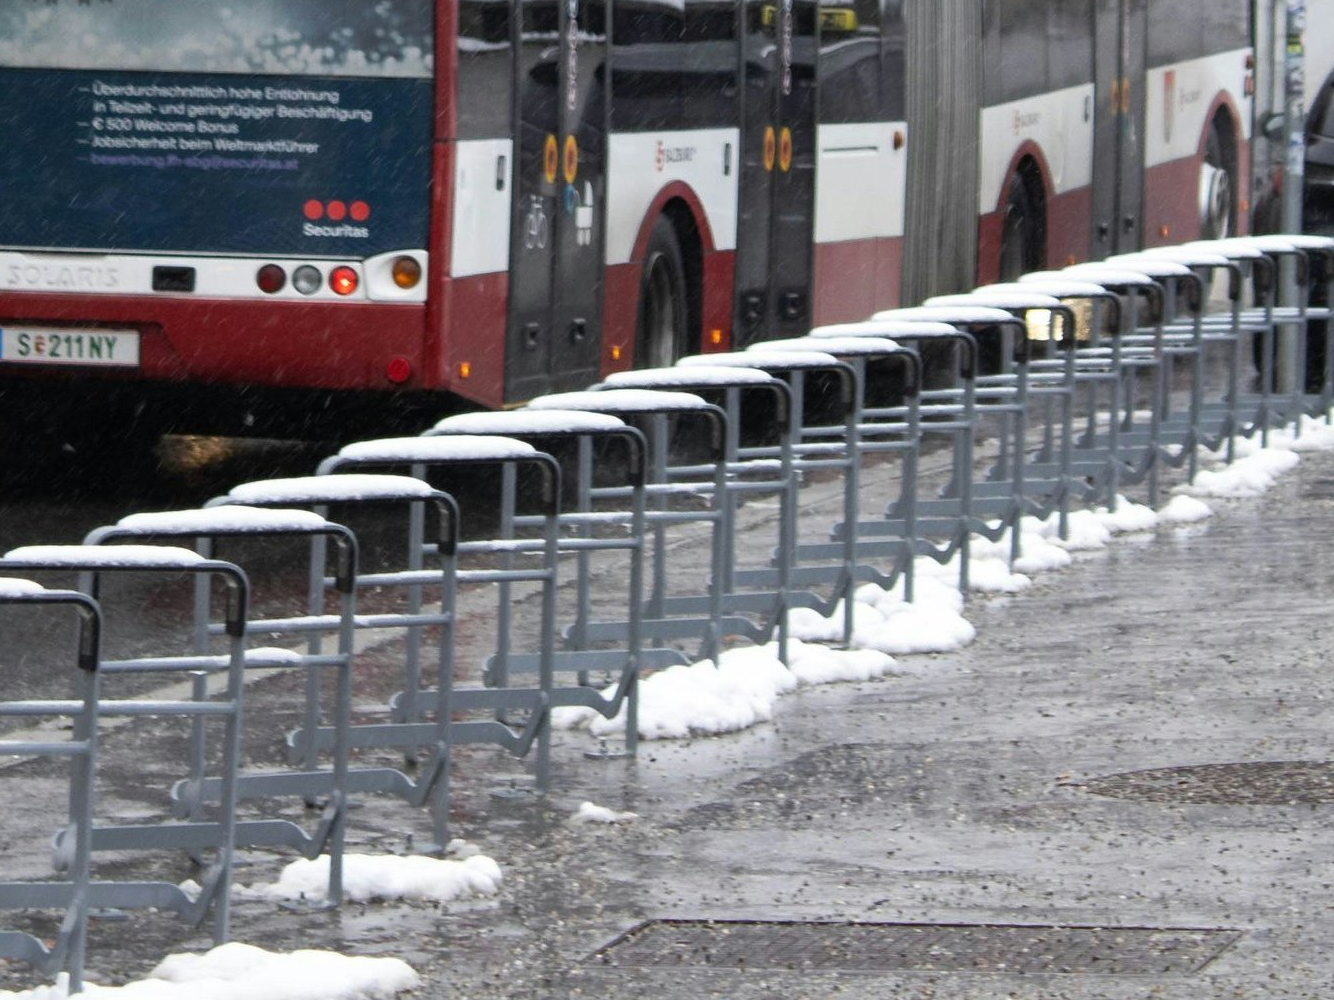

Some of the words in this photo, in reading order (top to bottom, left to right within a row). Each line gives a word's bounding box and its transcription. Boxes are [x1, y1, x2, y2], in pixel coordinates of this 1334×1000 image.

[91, 80, 228, 99] Überdurchschnittlich
[229, 87, 263, 100] hohe
[265, 87, 340, 104] Entlohnung
[93, 101, 107, 114] in
[159, 103, 185, 116] und
[186, 104, 275, 120] geringfügiger
[276, 105, 373, 123] Beschäftigung
[91, 118, 104, 131] €
[105, 118, 133, 132] 500
[135, 119, 196, 133] Welcome
[197, 120, 240, 134] Bonus
[91, 136, 177, 150] Jobsicherheit
[179, 137, 213, 150] beim
[215, 138, 320, 154] Weltmarktführer
[302, 222, 370, 238] Securitas
[7, 263, 119, 287] SOLARIS
